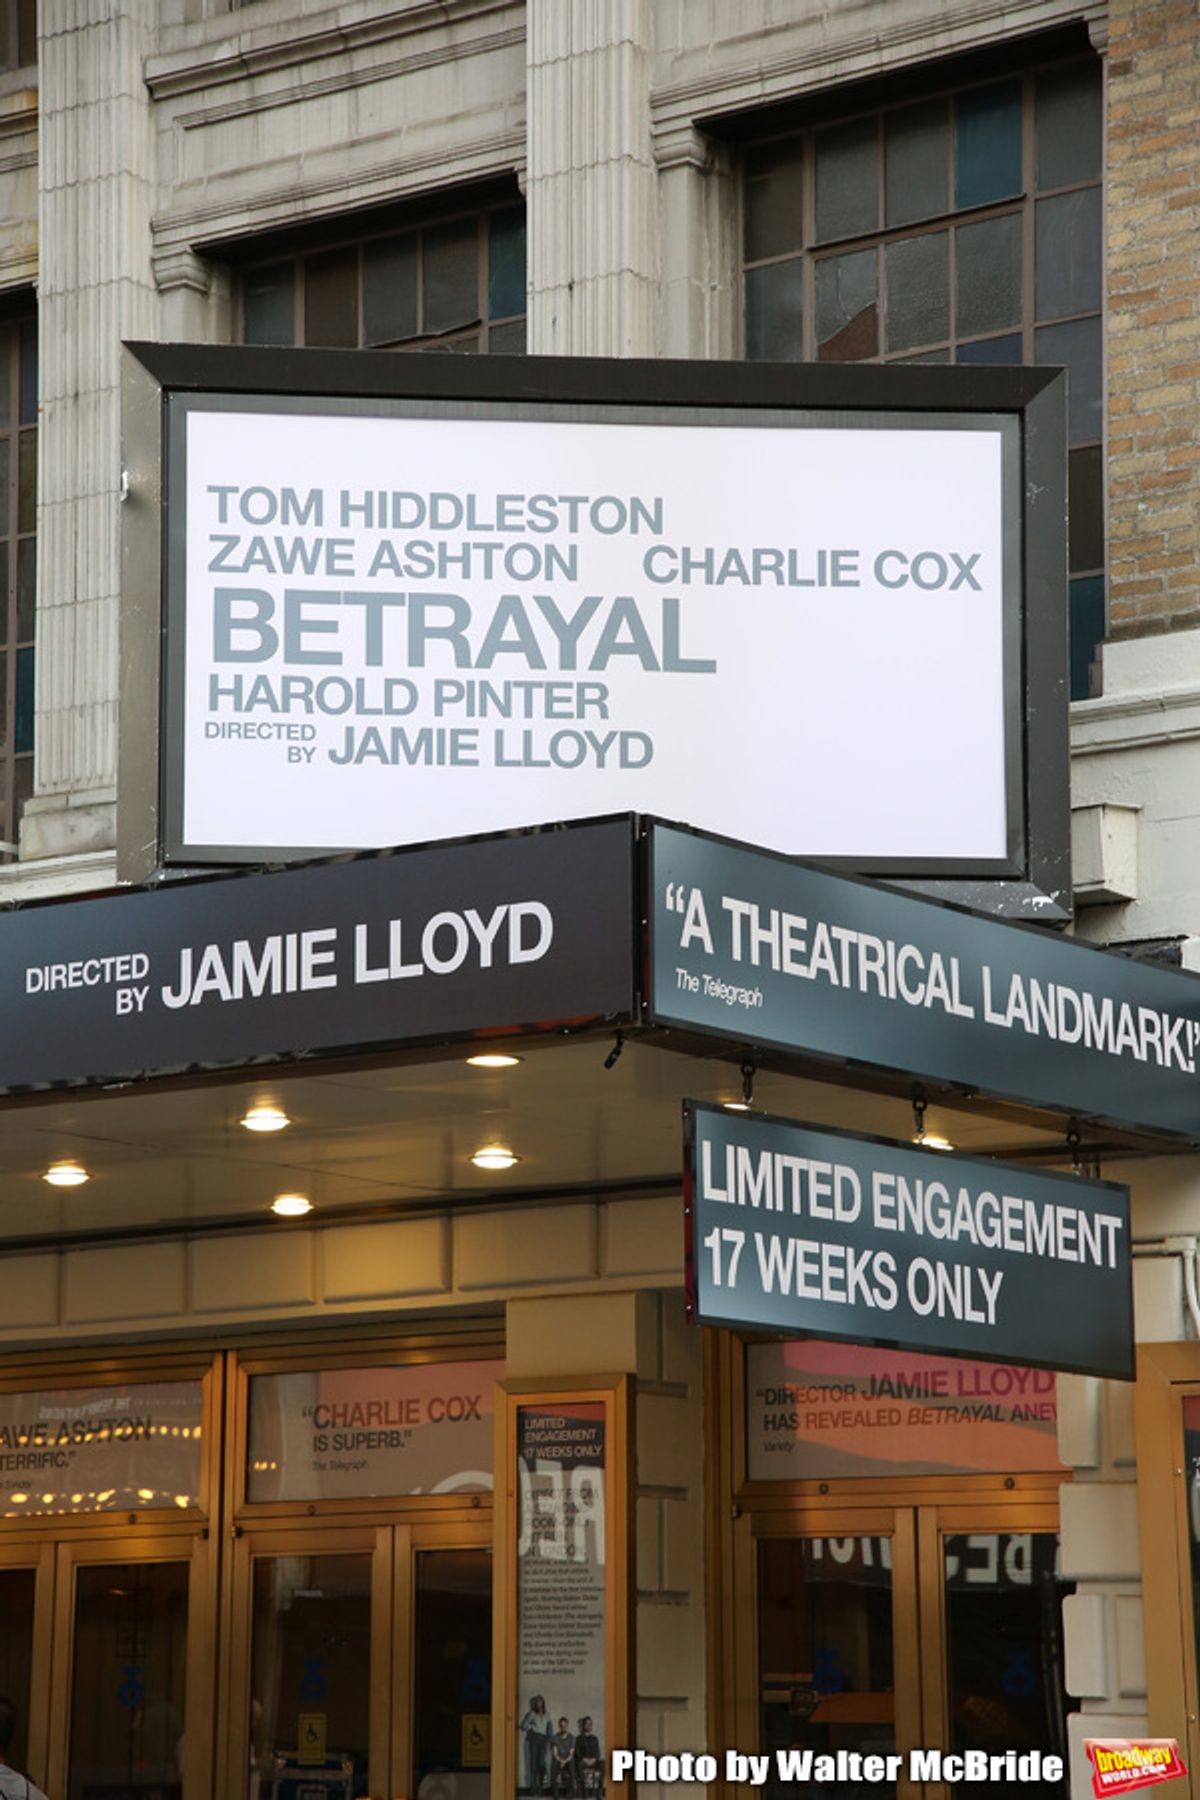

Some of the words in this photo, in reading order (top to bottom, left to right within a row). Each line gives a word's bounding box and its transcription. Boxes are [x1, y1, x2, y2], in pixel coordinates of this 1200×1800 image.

[207, 485, 323, 527] TOM
[340, 490, 663, 535] HIDDLESTON
[207, 534, 355, 577] ZAWE
[368, 540, 577, 582] ASHTON
[643, 544, 860, 587] CHARLIE
[873, 550, 983, 591] COX
[213, 587, 717, 674] BETRAYAL
[208, 674, 418, 716] HAROLD
[434, 679, 609, 719] PINTER
[204, 722, 316, 741] DIRECTED
[328, 726, 479, 766] JAMIE
[494, 729, 654, 769] LLOYD
[287, 746, 317, 764] BY
[26, 953, 149, 993] DIRECTED
[162, 928, 337, 1009] JAMIE
[355, 901, 554, 984] LLOYD
[722, 896, 974, 1019] THEATRICAL
[115, 986, 149, 1015] BY
[675, 967, 700, 993] The
[702, 974, 763, 1009] Telegraph
[702, 1140, 861, 1223] LIMITED
[872, 1171, 1122, 1269] ENGAGEMENT
[704, 1227, 745, 1288] 17
[754, 1232, 897, 1312] WEEKS
[907, 1256, 1003, 1325] ONLY
[861, 1370, 949, 1401] JAMIE
[957, 1367, 1056, 1397] LLOYD
[427, 1395, 482, 1423] COX
[525, 1418, 566, 1429] LIMITED
[764, 1412, 798, 1432] HAS
[805, 1408, 902, 1430] REVEALED
[907, 1405, 1004, 1426] BETRAYAL
[55, 1416, 152, 1446] ASHTON
[313, 1434, 328, 1453] IS
[525, 1429, 597, 1444] ENGAGEMENT
[536, 1446, 573, 1459] WEEKS
[574, 1444, 602, 1458] ONLY
